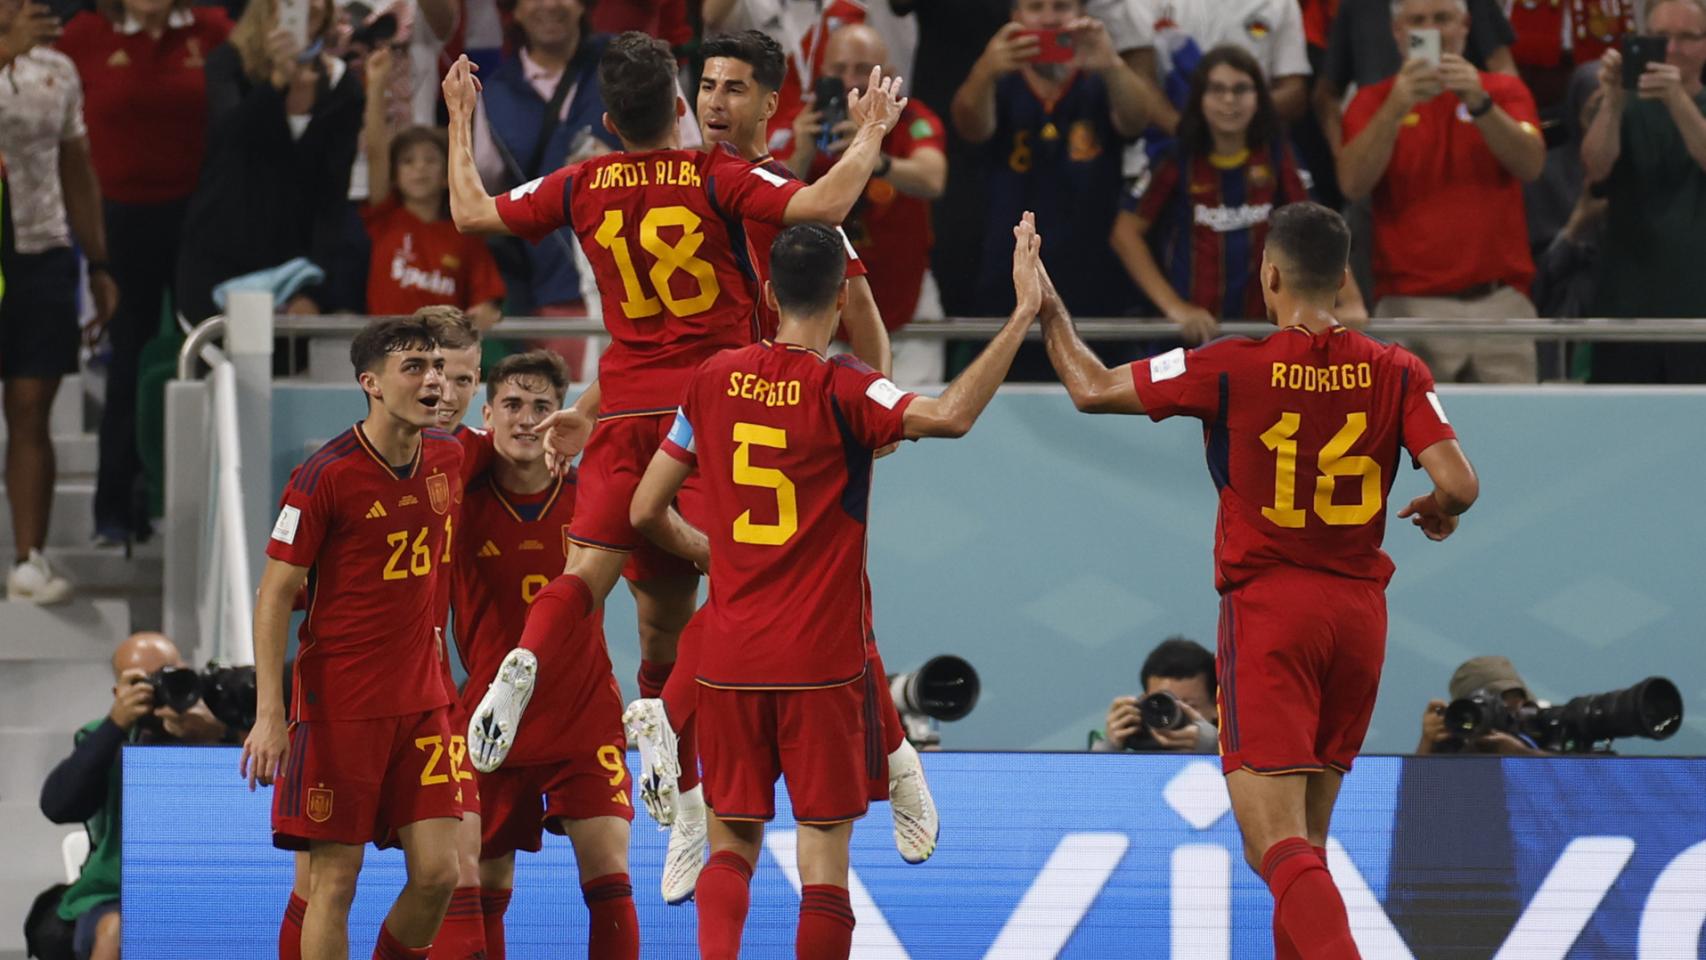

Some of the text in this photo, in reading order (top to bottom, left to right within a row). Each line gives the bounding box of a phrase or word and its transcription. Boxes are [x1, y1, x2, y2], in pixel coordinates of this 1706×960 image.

[589, 161, 649, 190] JORDI
[594, 205, 721, 319] 18
[727, 371, 801, 407] SERGIO
[1271, 361, 1372, 393] RODRIGO
[732, 422, 798, 546] 5
[1259, 412, 1382, 528] 16
[383, 526, 431, 580] 26
[597, 745, 625, 786] 9
[764, 760, 1706, 960] viv
